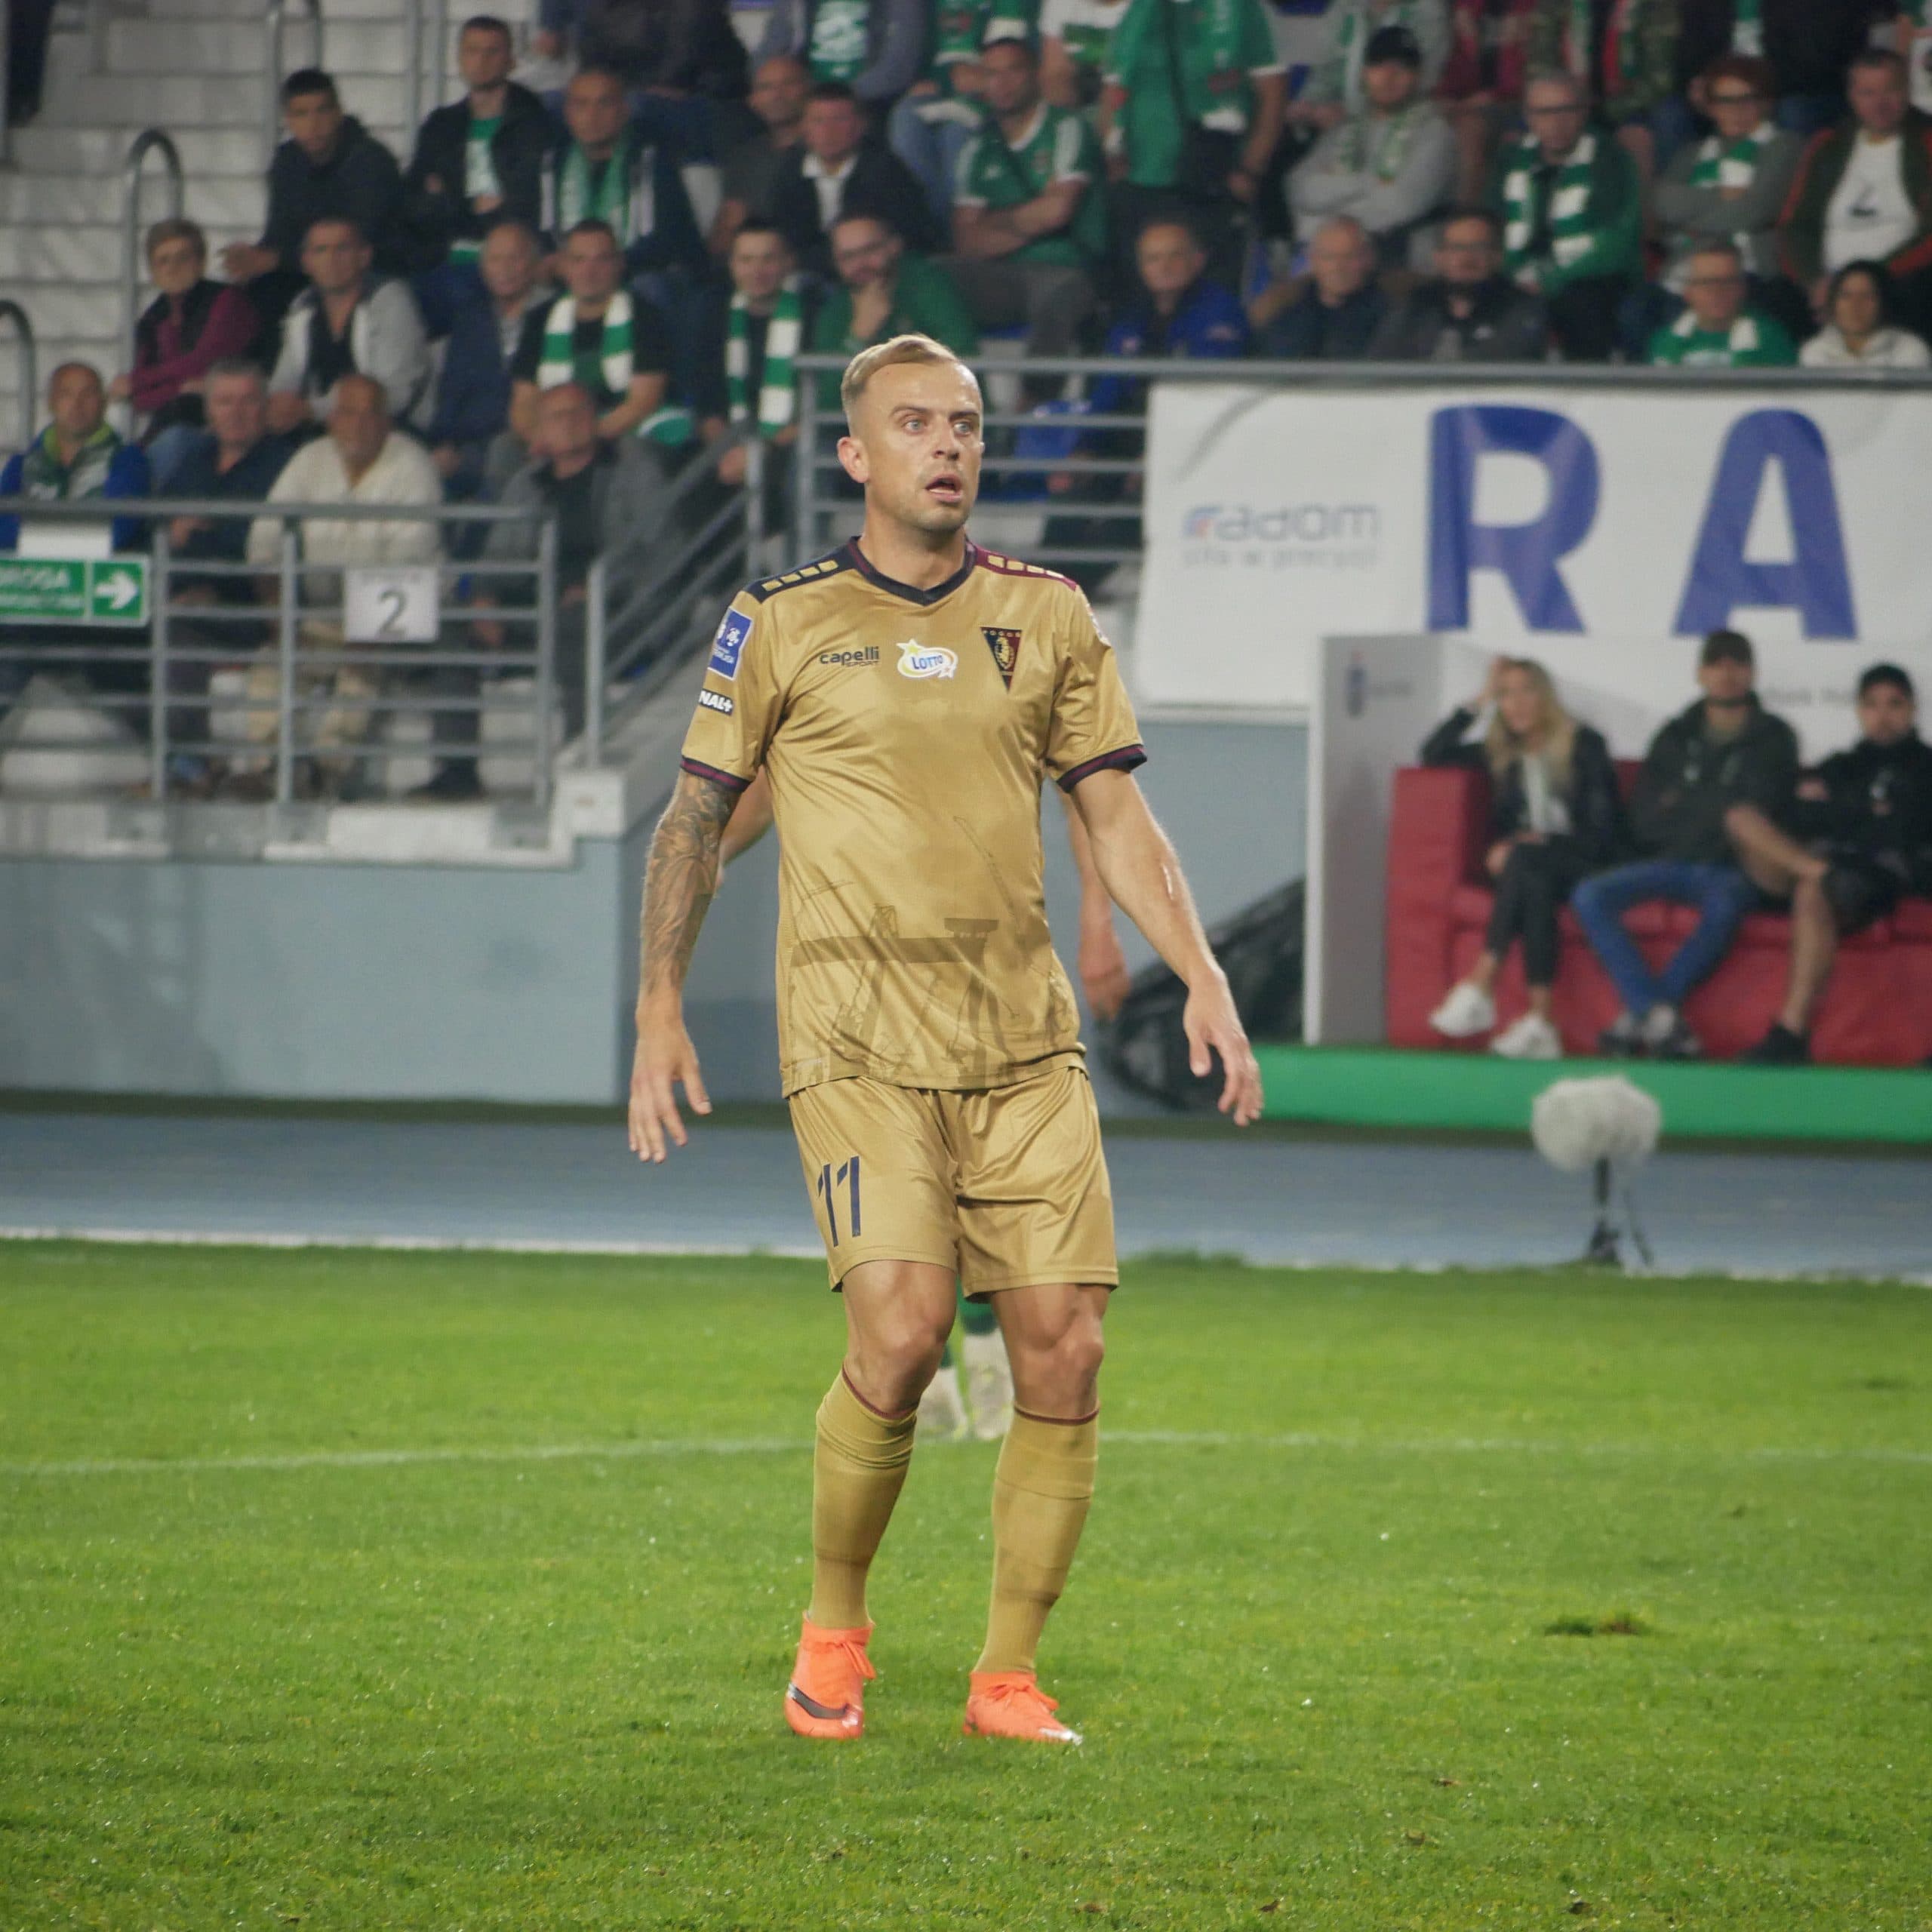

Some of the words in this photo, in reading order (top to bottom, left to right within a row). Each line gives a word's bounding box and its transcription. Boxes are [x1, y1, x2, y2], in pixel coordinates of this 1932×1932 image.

[377, 588, 407, 641] 2
[820, 646, 880, 666] capelli
[911, 654, 943, 670] LOTTO
[817, 1155, 861, 1247] 11
